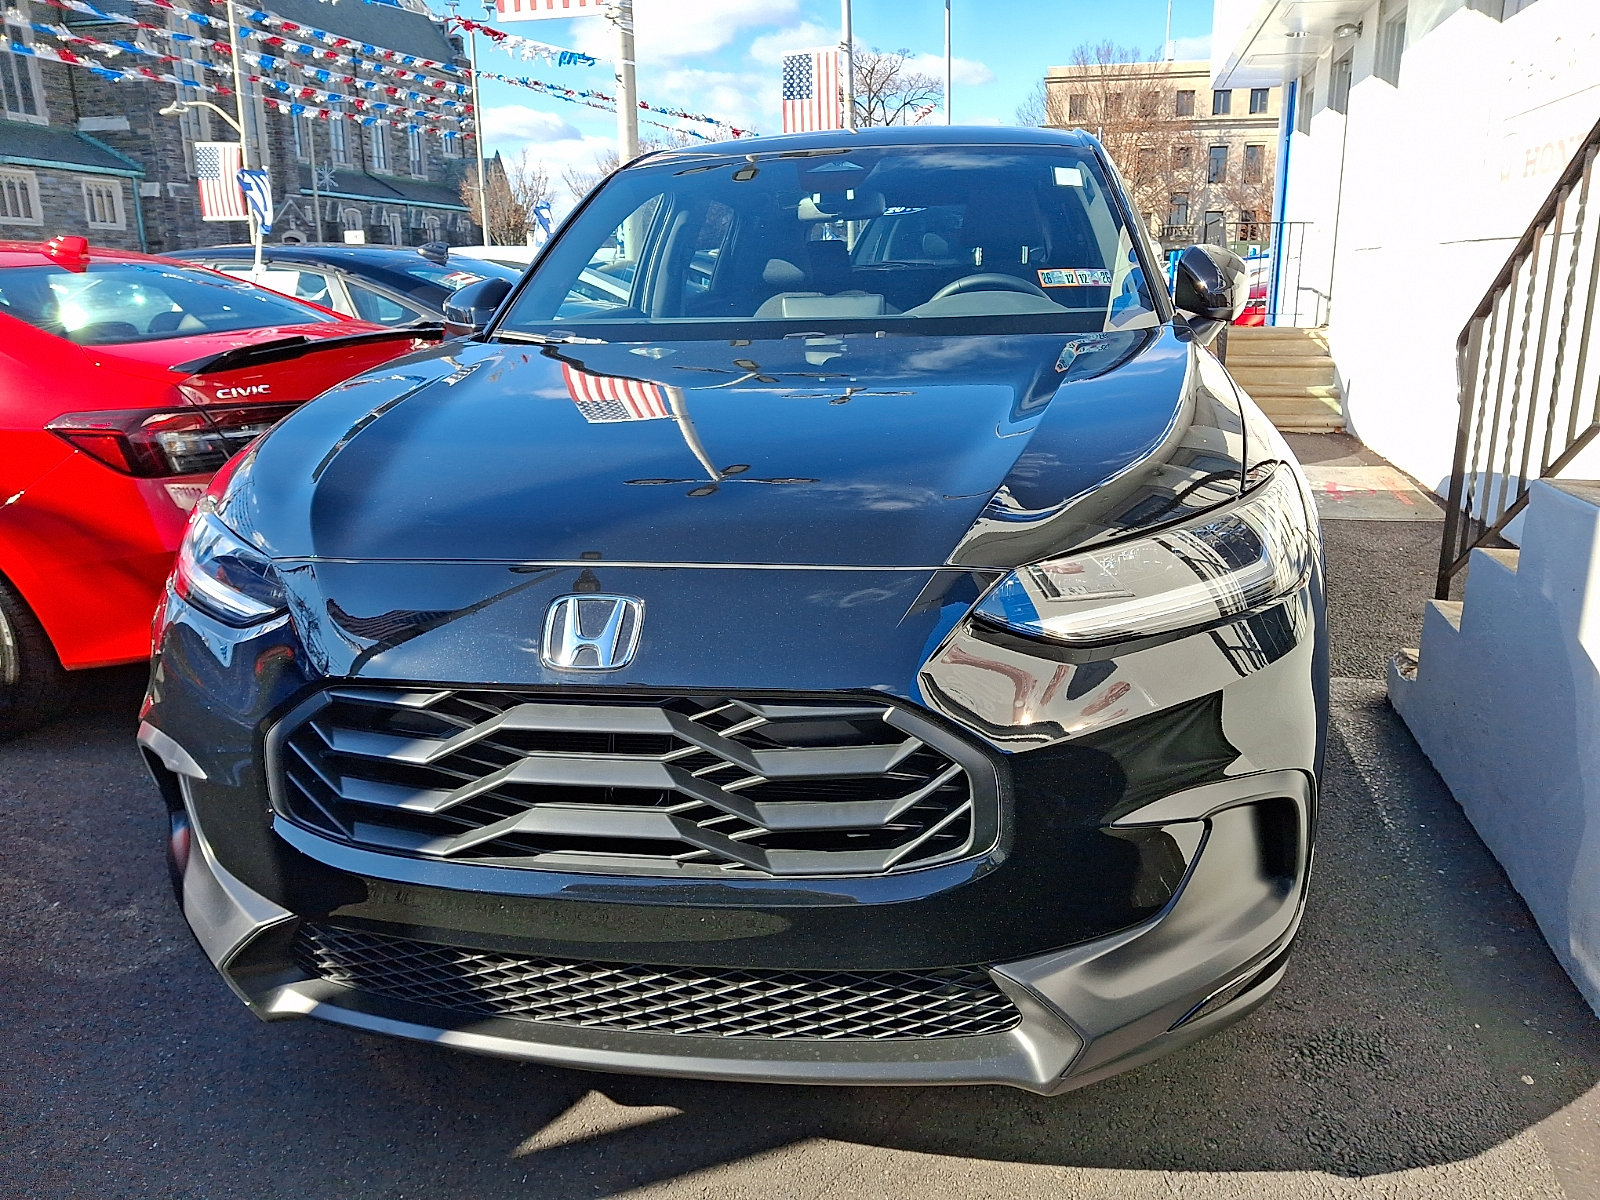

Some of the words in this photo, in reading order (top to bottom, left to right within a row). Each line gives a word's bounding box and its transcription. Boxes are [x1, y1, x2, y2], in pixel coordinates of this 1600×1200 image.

[1041, 272, 1053, 284] 26
[1065, 273, 1076, 284] 12
[1078, 273, 1089, 284] 12
[1100, 271, 1112, 284] 26
[216, 384, 271, 399] CIVIC
